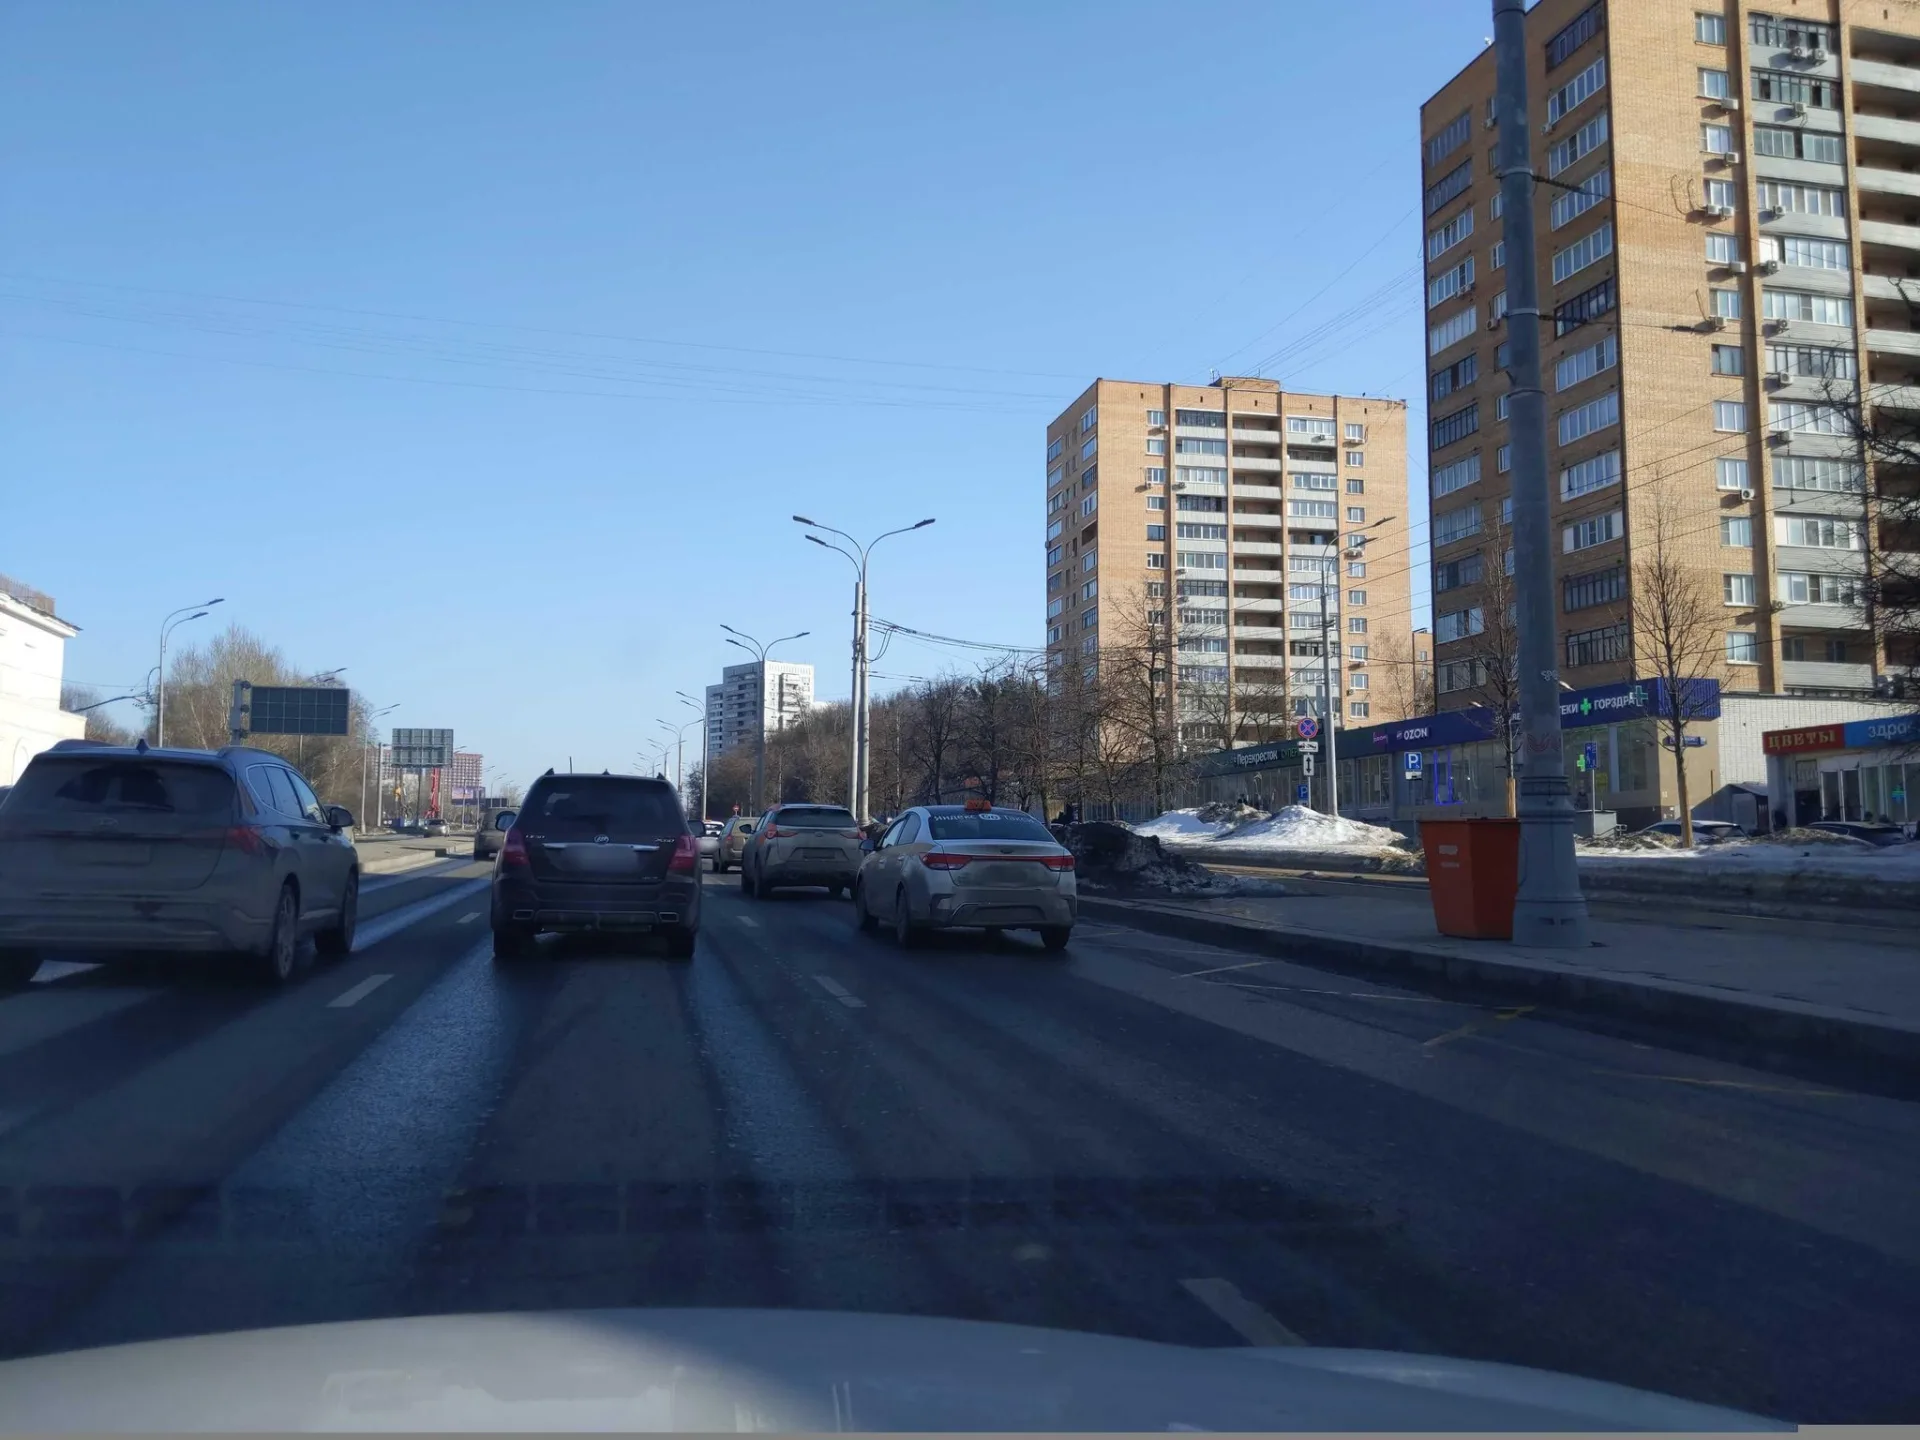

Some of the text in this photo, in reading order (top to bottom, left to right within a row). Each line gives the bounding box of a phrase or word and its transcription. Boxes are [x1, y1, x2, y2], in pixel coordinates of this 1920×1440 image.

[1403, 727, 1428, 741] OZON
[1769, 730, 1836, 750] ЦВЕТЫ
[1408, 753, 1419, 769] P
